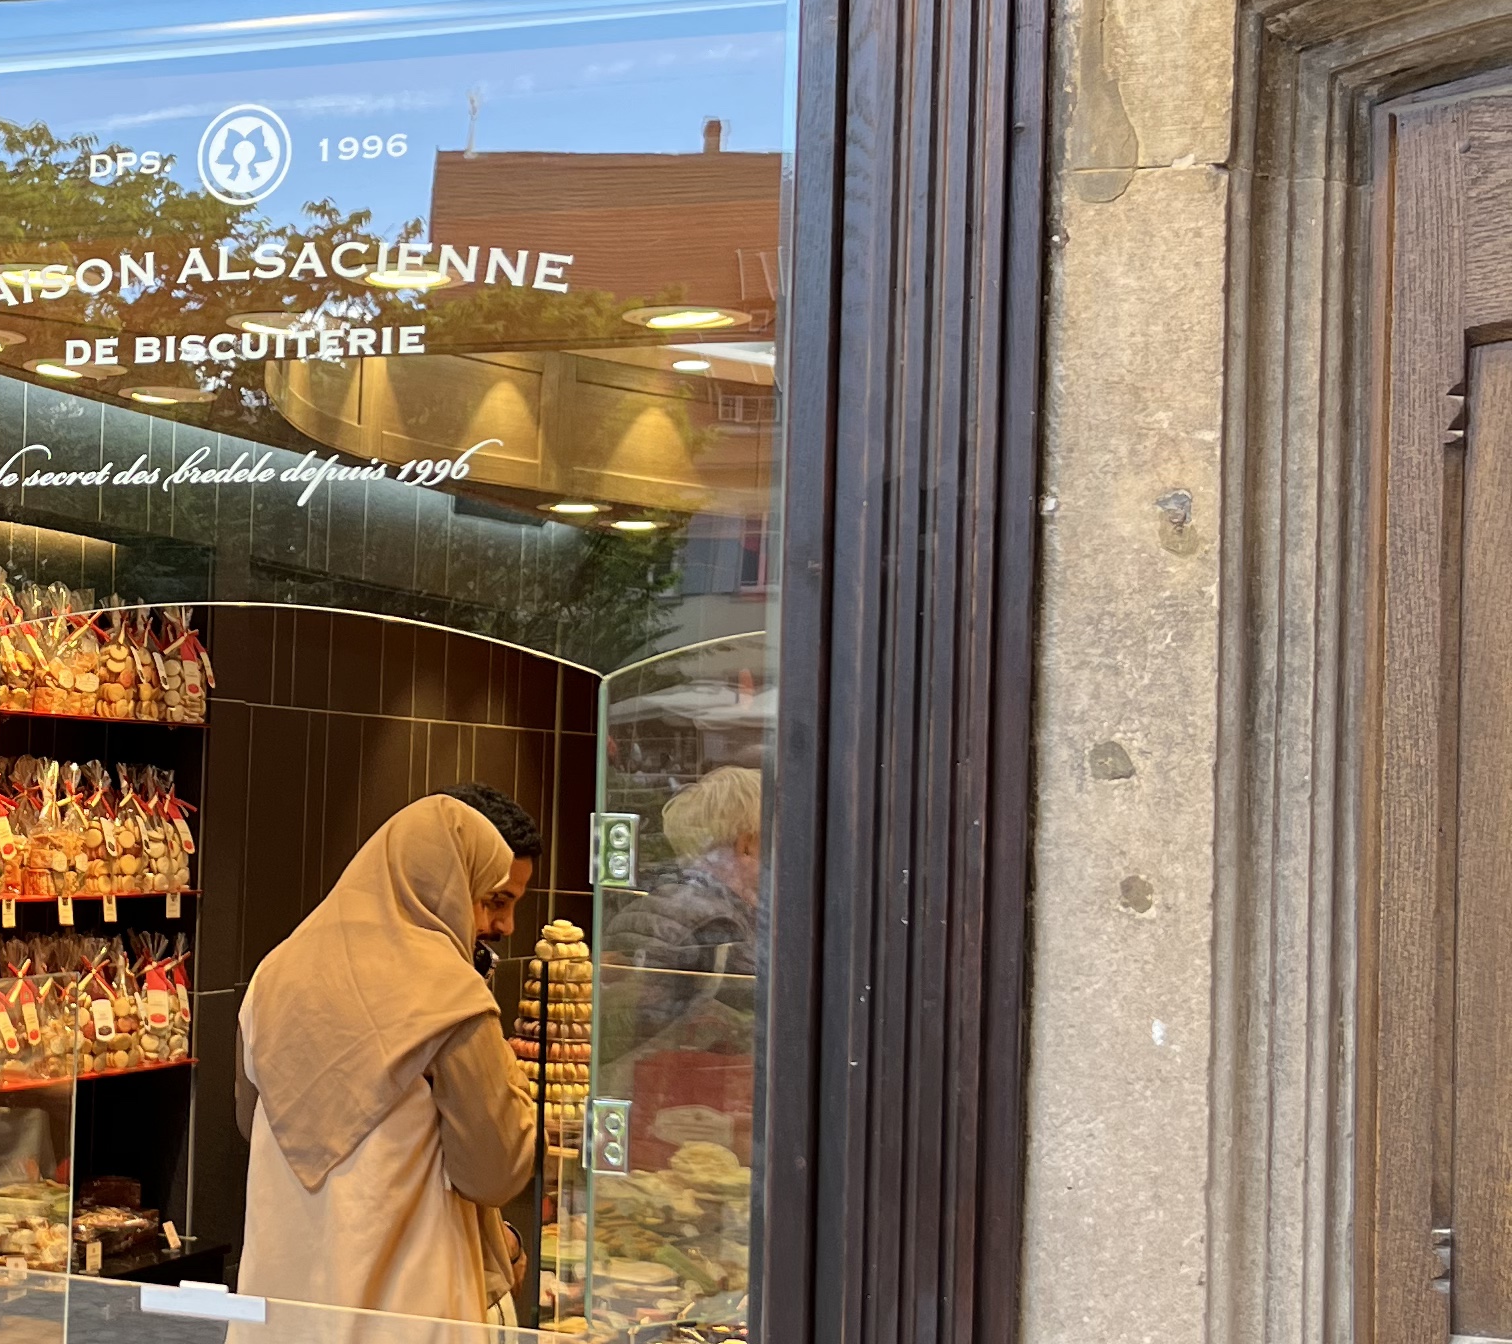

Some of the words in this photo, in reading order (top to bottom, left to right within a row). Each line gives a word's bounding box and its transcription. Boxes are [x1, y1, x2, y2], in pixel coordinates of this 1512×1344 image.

[319, 133, 408, 163] 1996
[177, 241, 574, 294] ALSACIENNE
[65, 337, 119, 366] DE
[134, 325, 426, 364] BISCUITERIE
[22, 462, 114, 488] secret
[112, 454, 161, 486] des
[163, 446, 276, 492] bredele
[280, 450, 388, 507] depuis
[396, 438, 504, 487] 1996
